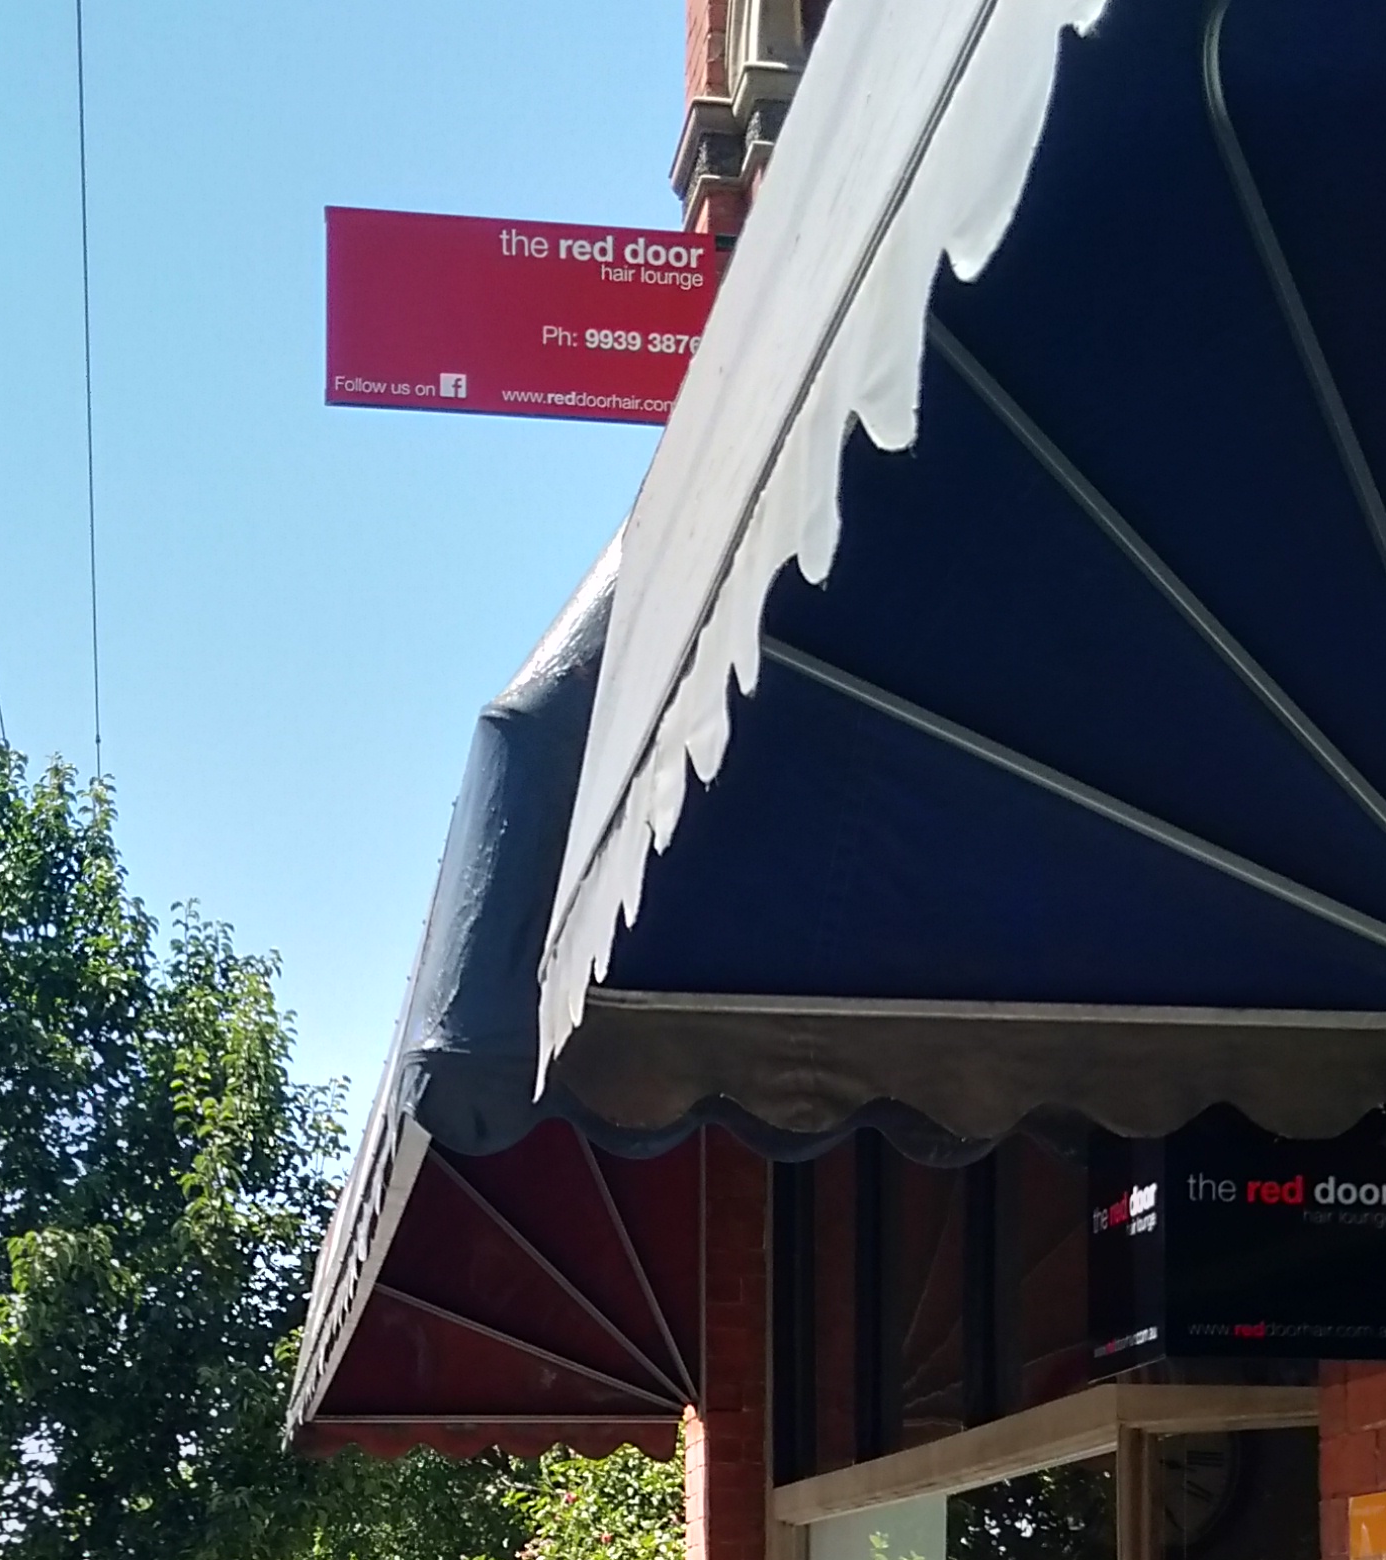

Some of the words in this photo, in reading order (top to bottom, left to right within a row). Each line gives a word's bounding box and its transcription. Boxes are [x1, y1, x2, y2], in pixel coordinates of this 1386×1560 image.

[500, 229, 549, 258] the
[558, 235, 614, 263] red
[624, 237, 705, 269] door
[600, 263, 635, 283] hair
[640, 267, 703, 290] lounge
[542, 326, 578, 347] Ph:
[584, 328, 641, 351] 9939
[647, 332, 702, 355] 3876
[334, 376, 387, 393] Follow
[391, 384, 411, 395] us
[415, 384, 435, 396] on
[1186, 1172, 1236, 1202] the
[1245, 1174, 1305, 1205] red
[1093, 1207, 1108, 1234] the
[1109, 1191, 1128, 1227] red
[1129, 1182, 1158, 1217] door
[1302, 1208, 1331, 1225] hair
